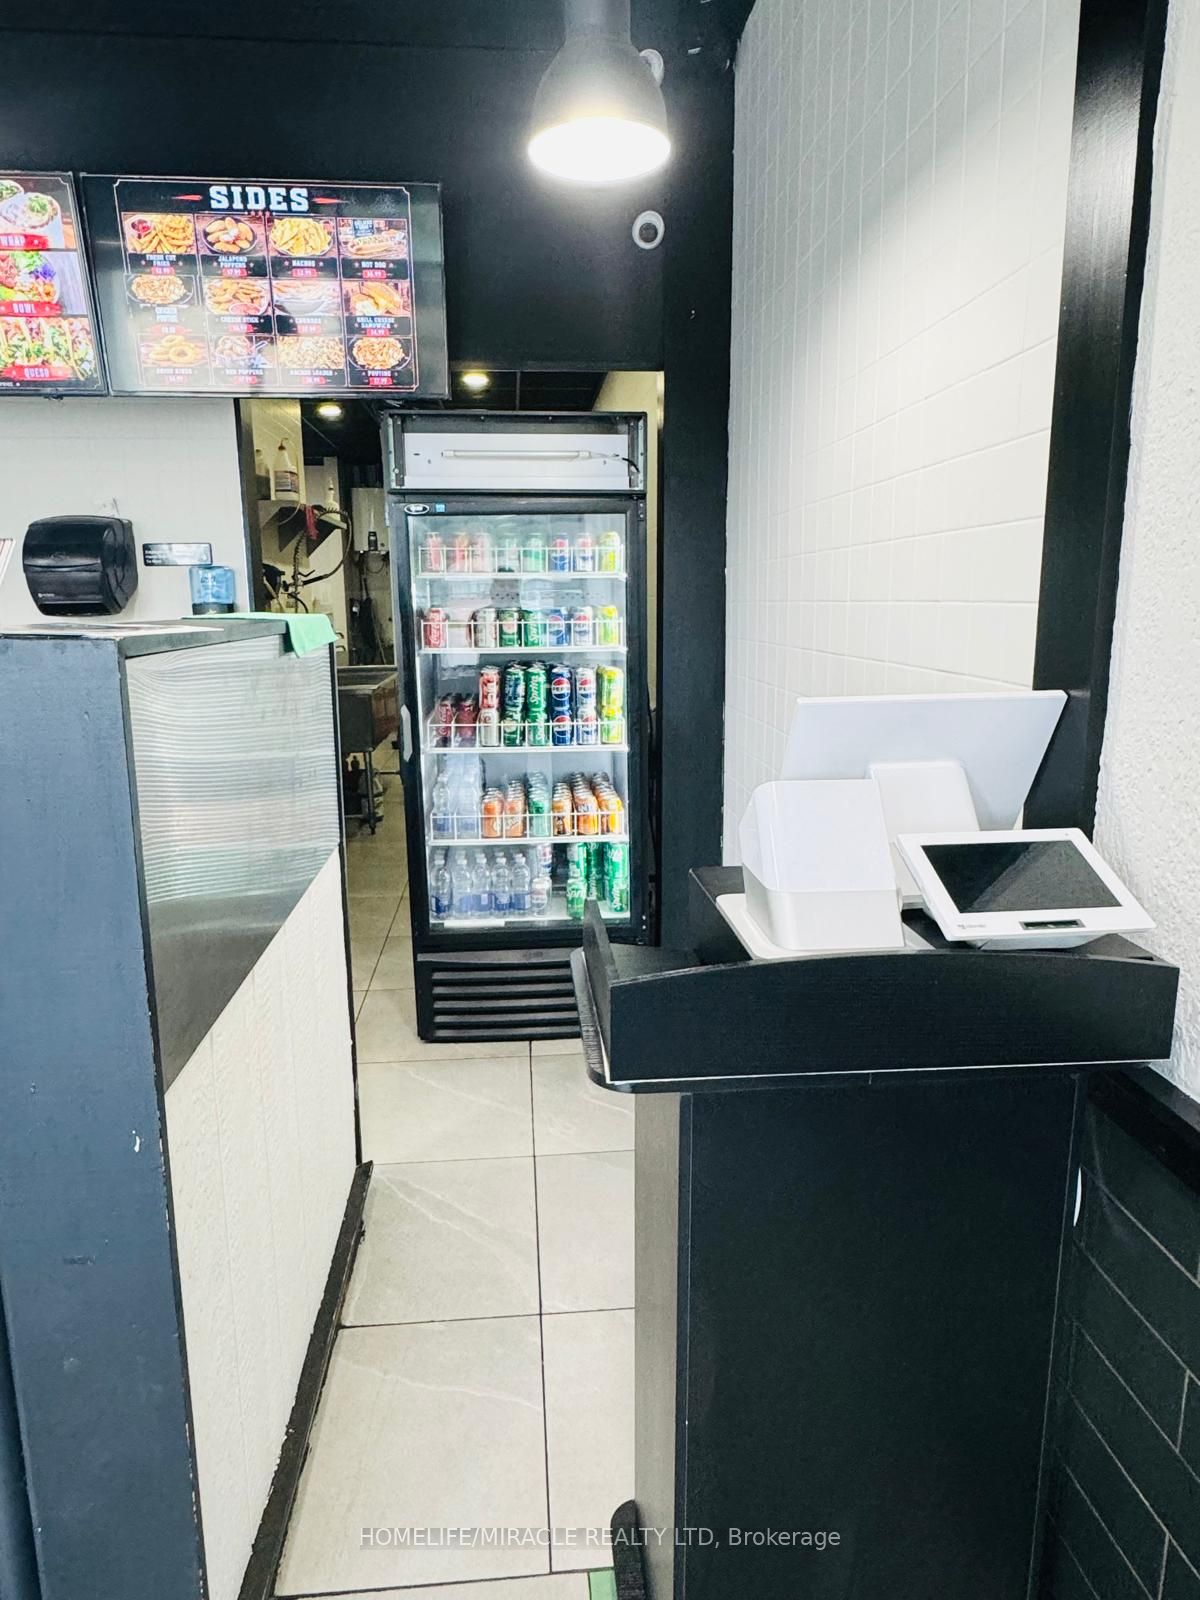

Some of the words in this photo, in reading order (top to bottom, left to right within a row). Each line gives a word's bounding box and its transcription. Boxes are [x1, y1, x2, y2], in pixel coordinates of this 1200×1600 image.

[209, 185, 309, 212] SIDES
[12, 303, 37, 313] BOWL
[24, 367, 49, 378] QUESO
